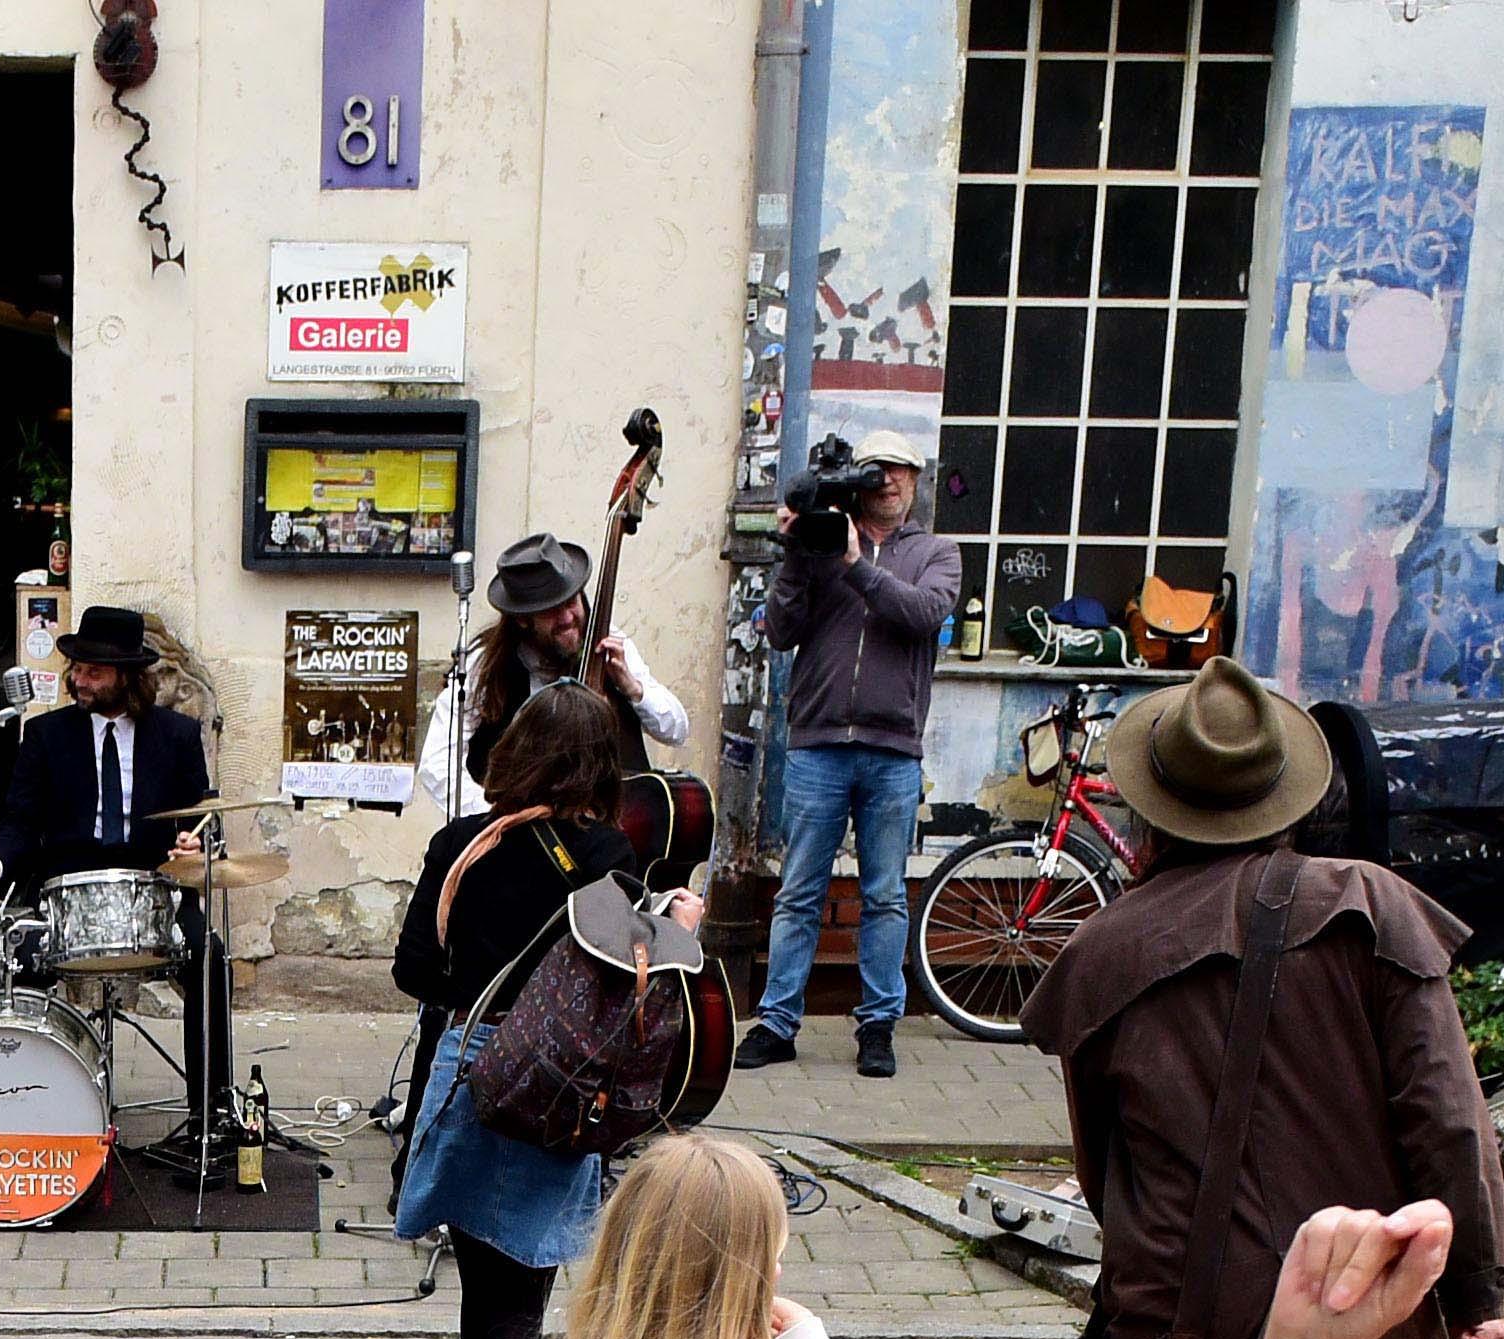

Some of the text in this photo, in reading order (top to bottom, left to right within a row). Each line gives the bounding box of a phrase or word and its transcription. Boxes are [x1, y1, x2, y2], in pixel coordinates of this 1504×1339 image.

[338, 95, 400, 165] 81
[1294, 197, 1354, 232] DIE
[1311, 228, 1458, 277] MAG
[276, 268, 456, 308] KOFFERFABRIK
[298, 321, 402, 349] Galerie
[292, 625, 410, 646] THE ROCKIN'
[296, 646, 408, 671] LAFAYETTES
